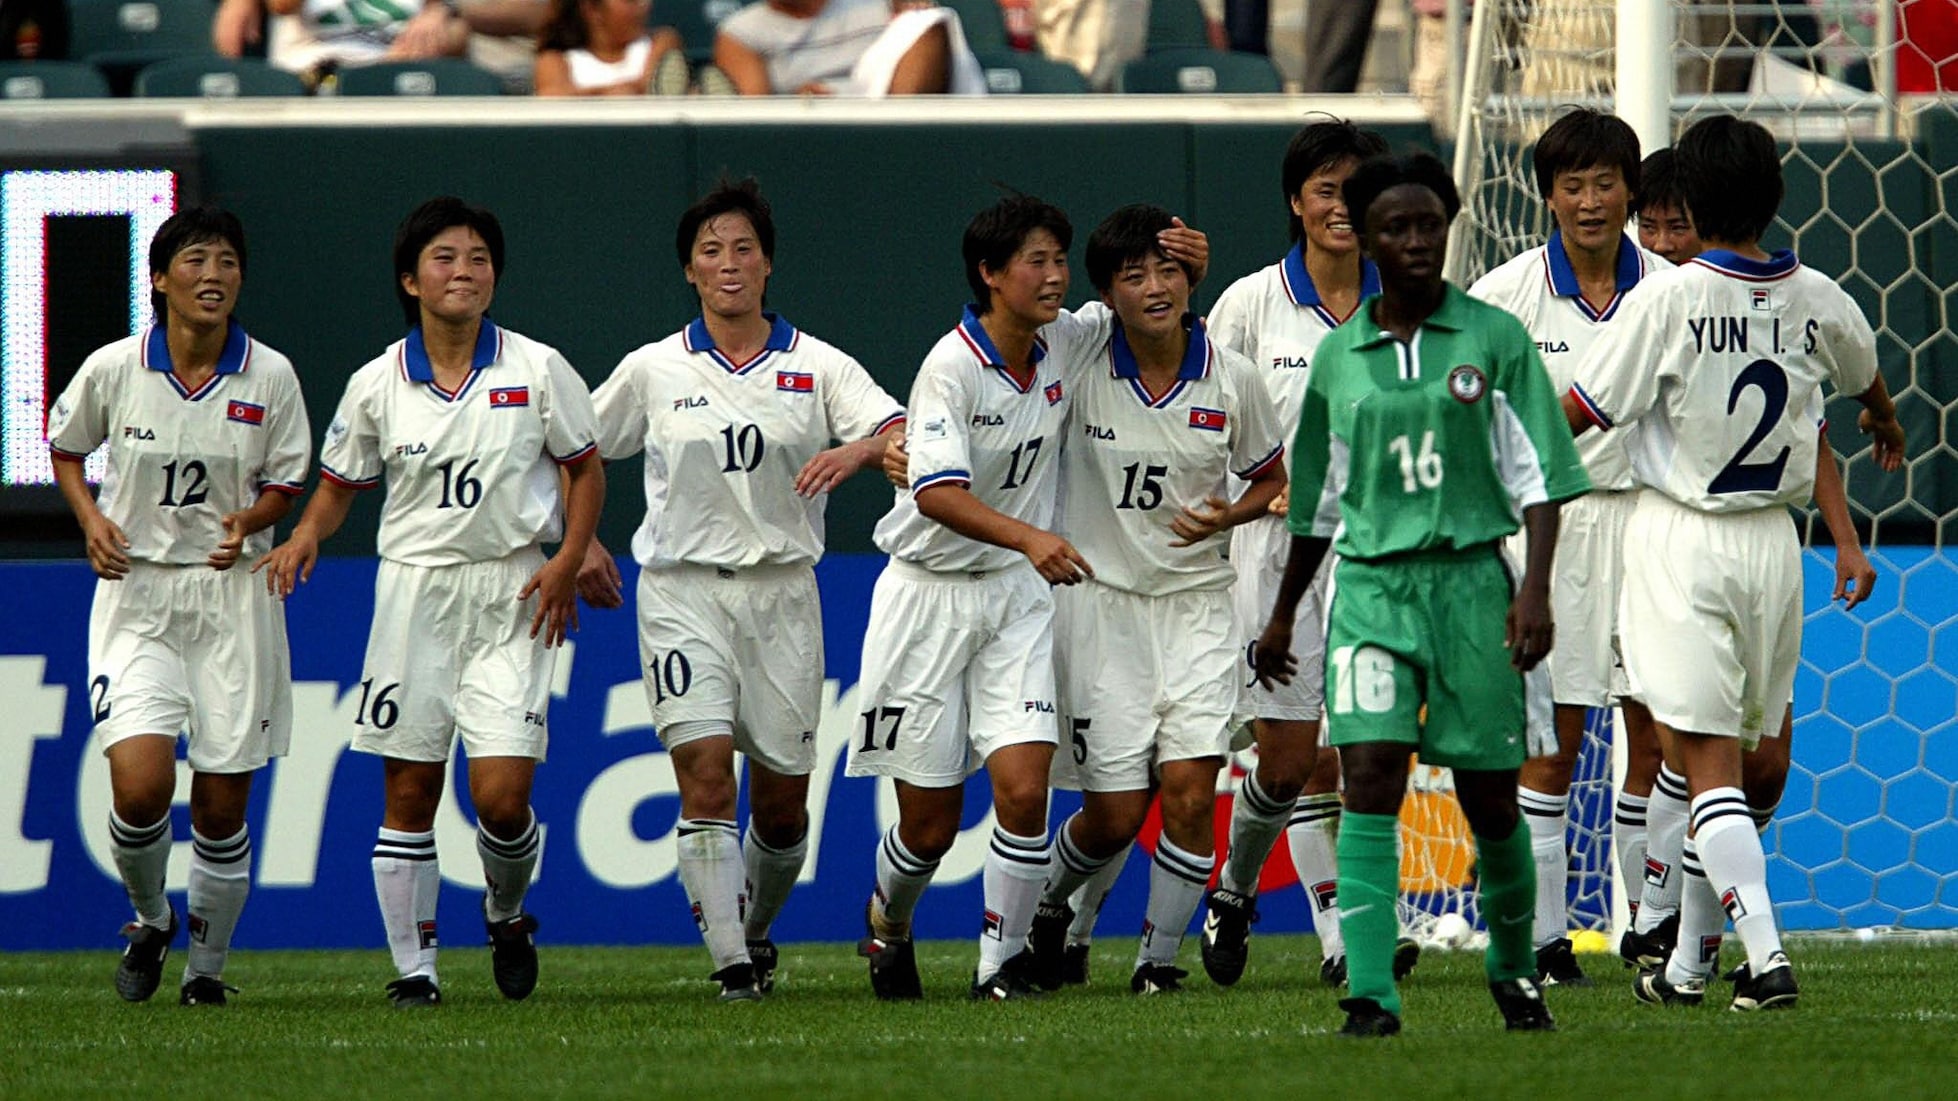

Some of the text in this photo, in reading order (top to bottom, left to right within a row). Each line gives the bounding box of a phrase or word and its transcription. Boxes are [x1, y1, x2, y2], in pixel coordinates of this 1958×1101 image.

[1688, 316, 1749, 354] YUN
[1273, 357, 1308, 370] FILA
[673, 395, 709, 412] FILA
[971, 413, 1004, 427] FILA
[1707, 358, 1792, 495] 2
[124, 427, 156, 441] FILA
[396, 442, 428, 457] FILA
[719, 422, 764, 473] 10
[1085, 424, 1116, 441] FILA
[158, 459, 210, 508] 12
[436, 459, 482, 509] 16
[999, 435, 1044, 490] 17
[1388, 430, 1443, 493] 16
[1116, 461, 1168, 511] 15
[650, 649, 692, 706] 10
[1332, 646, 1397, 714] 16
[354, 677, 400, 730] 16
[1025, 700, 1056, 714] FILA
[859, 706, 908, 753] 17
[1065, 717, 1090, 765] 5
